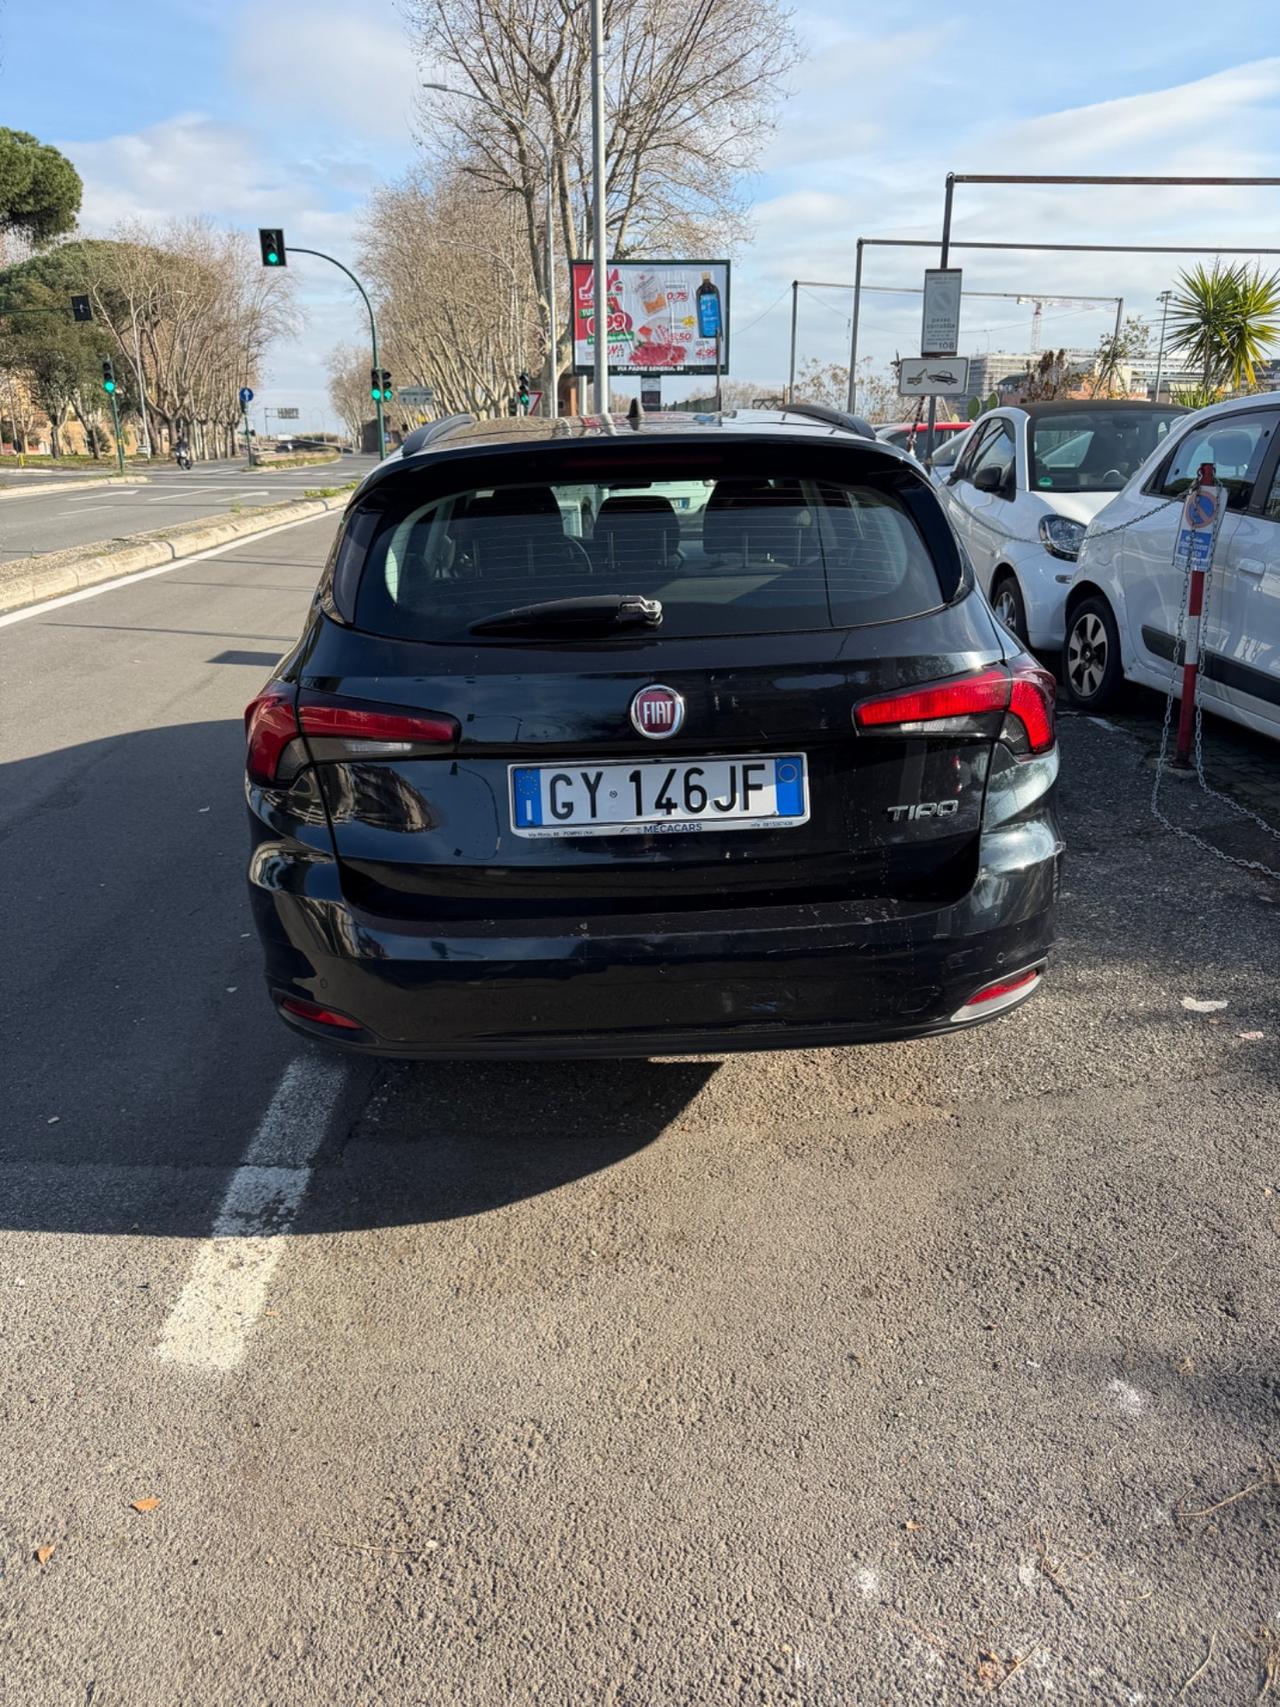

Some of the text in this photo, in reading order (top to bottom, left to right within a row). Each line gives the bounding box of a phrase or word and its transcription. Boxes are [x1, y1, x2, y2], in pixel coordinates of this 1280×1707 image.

[938, 341, 955, 350] 108
[643, 700, 673, 724] FIAT
[549, 763, 767, 820] GY 146JF
[887, 799, 959, 822] TIPO
[644, 823, 702, 833] MECACARS
